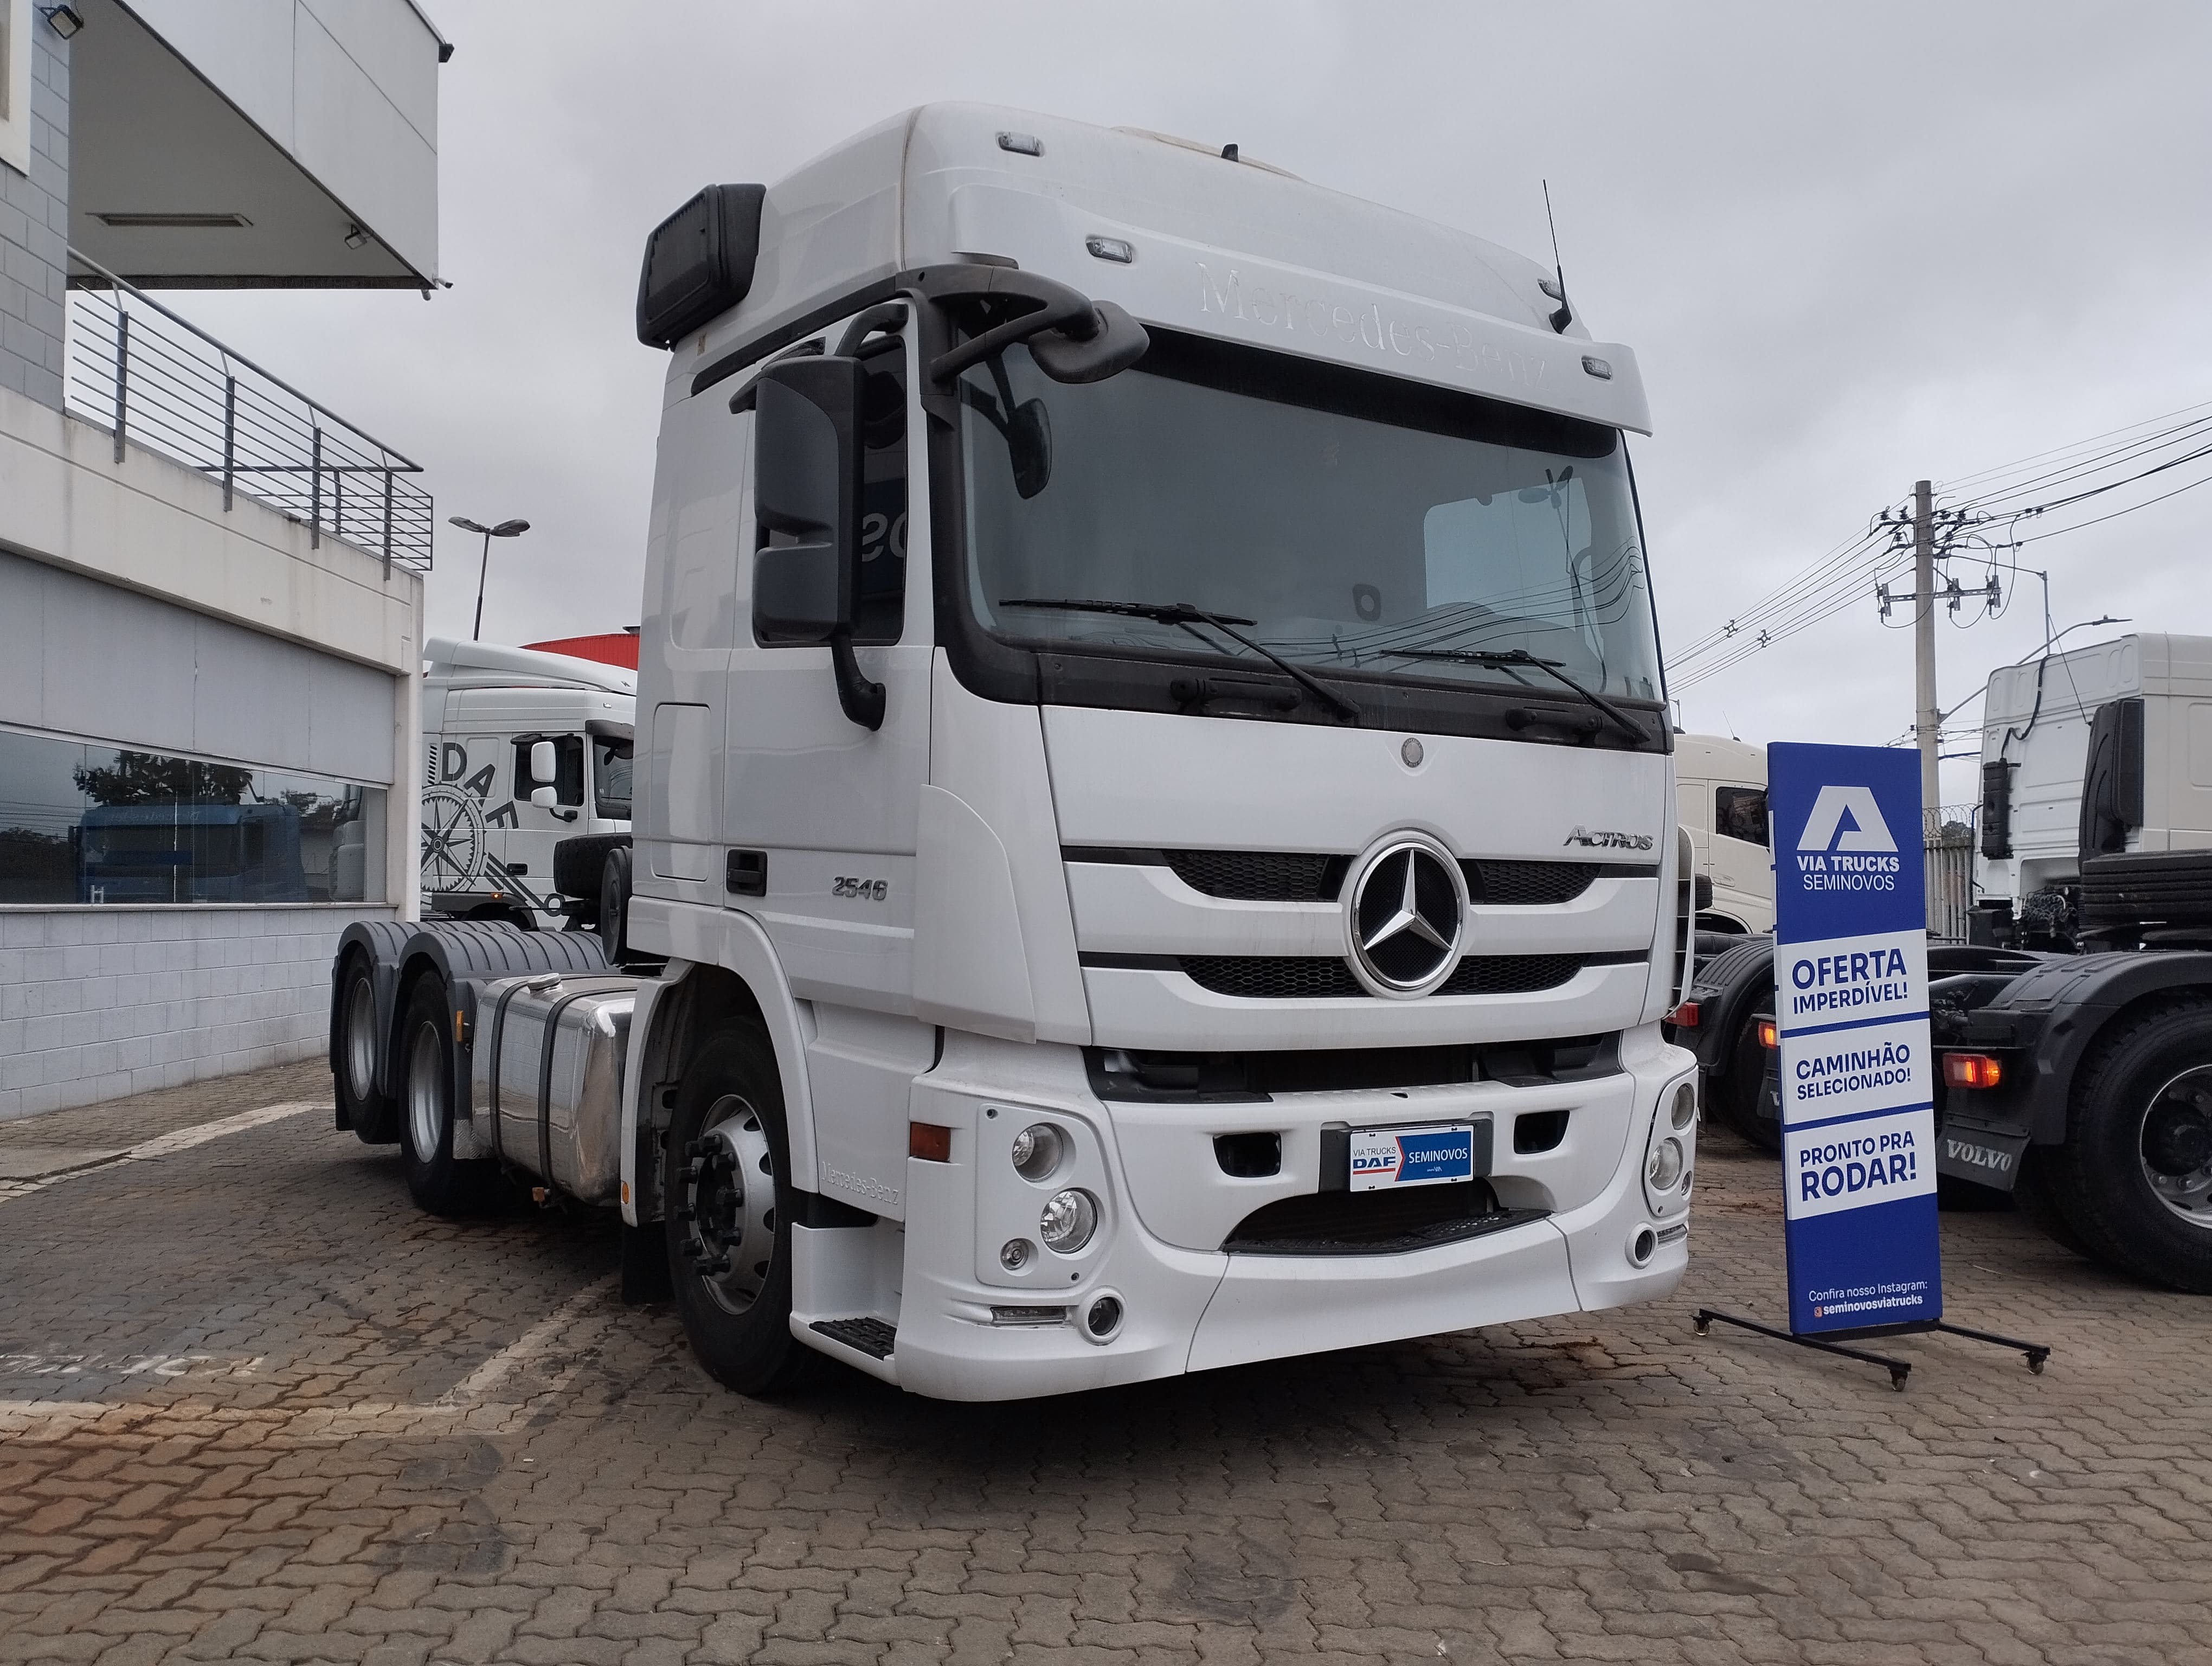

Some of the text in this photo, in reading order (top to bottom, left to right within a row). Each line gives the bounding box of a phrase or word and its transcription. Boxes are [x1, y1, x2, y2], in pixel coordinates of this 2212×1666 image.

[1195, 261, 1551, 391] Mercedes-Benz
[441, 742, 519, 830] DAF
[1797, 855, 1900, 873] VIA TRUCKS
[832, 876, 889, 901] 2546
[1803, 874, 1895, 891] SEMINOVOS
[1791, 947, 1907, 990] OFERTA
[1793, 981, 1908, 1015] IMPERDÍVEL!
[1796, 1041, 1911, 1080] CAMINHÃO
[1797, 1067, 1911, 1100] SELECIONADO!
[1353, 1156, 1396, 1169] DAF
[1367, 1146, 1397, 1155] TRUCKS
[1409, 1148, 1468, 1164] SEMINOVOS
[1800, 1130, 1915, 1168] PRONTO PRA
[1947, 1139, 2013, 1172] VOLVO
[1801, 1151, 1917, 1202] RODAR!
[1809, 1279, 1928, 1302] Confira nosso Instagram:
[1823, 1294, 1923, 1316] seminovosviatrucks
